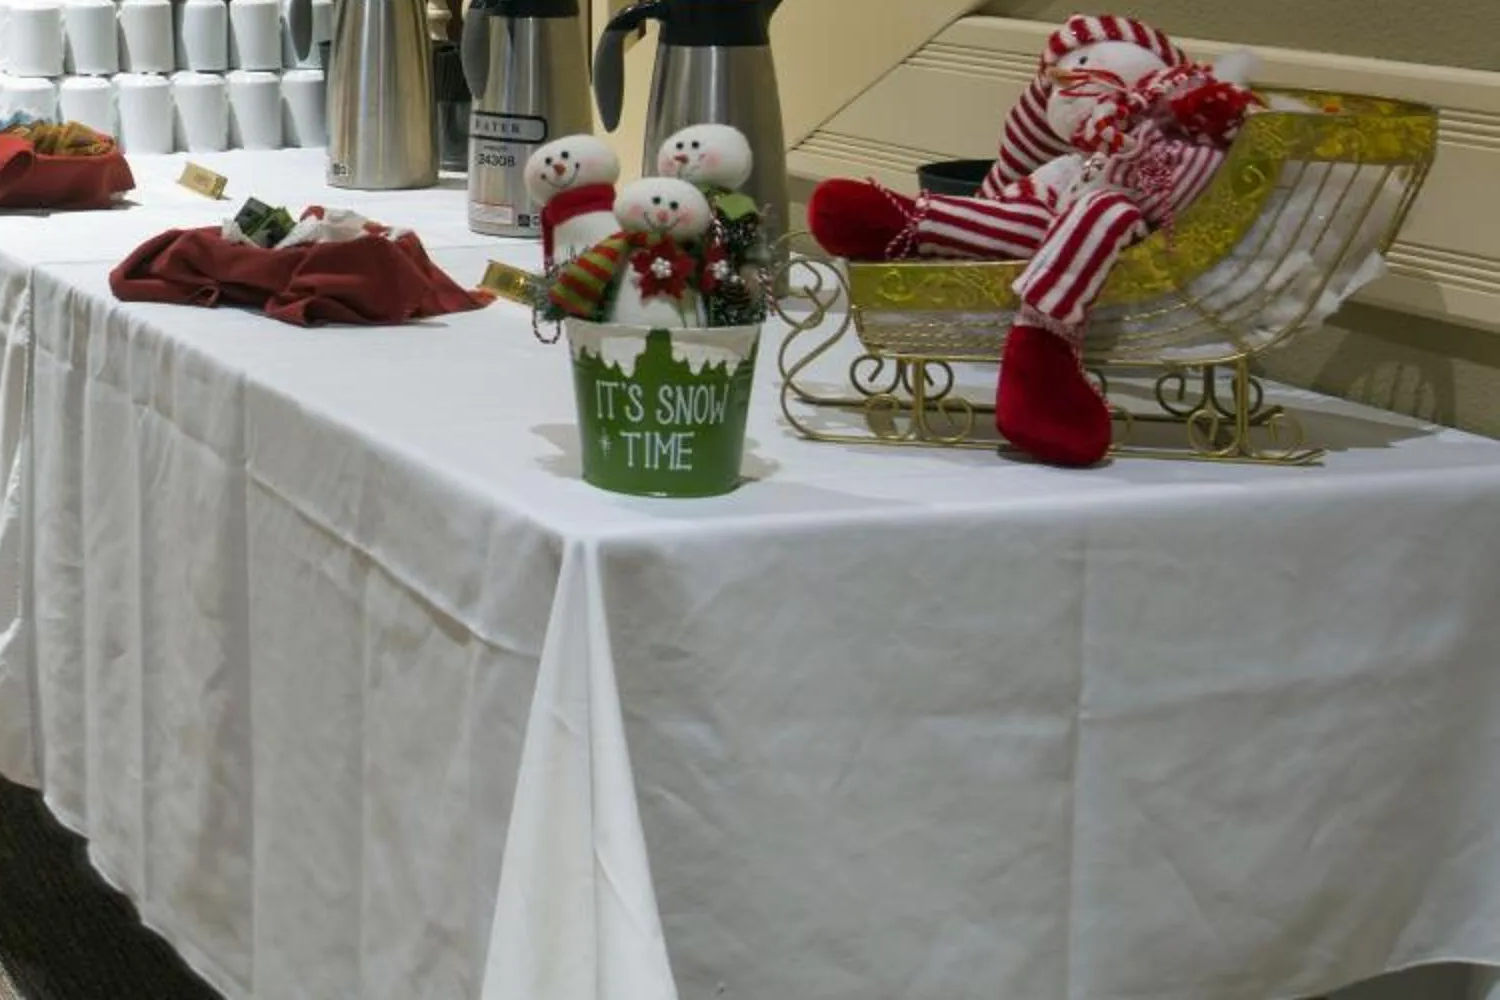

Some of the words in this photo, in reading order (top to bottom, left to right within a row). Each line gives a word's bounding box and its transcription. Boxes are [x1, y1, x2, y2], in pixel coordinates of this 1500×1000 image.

[596, 380, 644, 423] IT'S
[656, 383, 729, 425] SNOW
[619, 431, 695, 471] TIME
